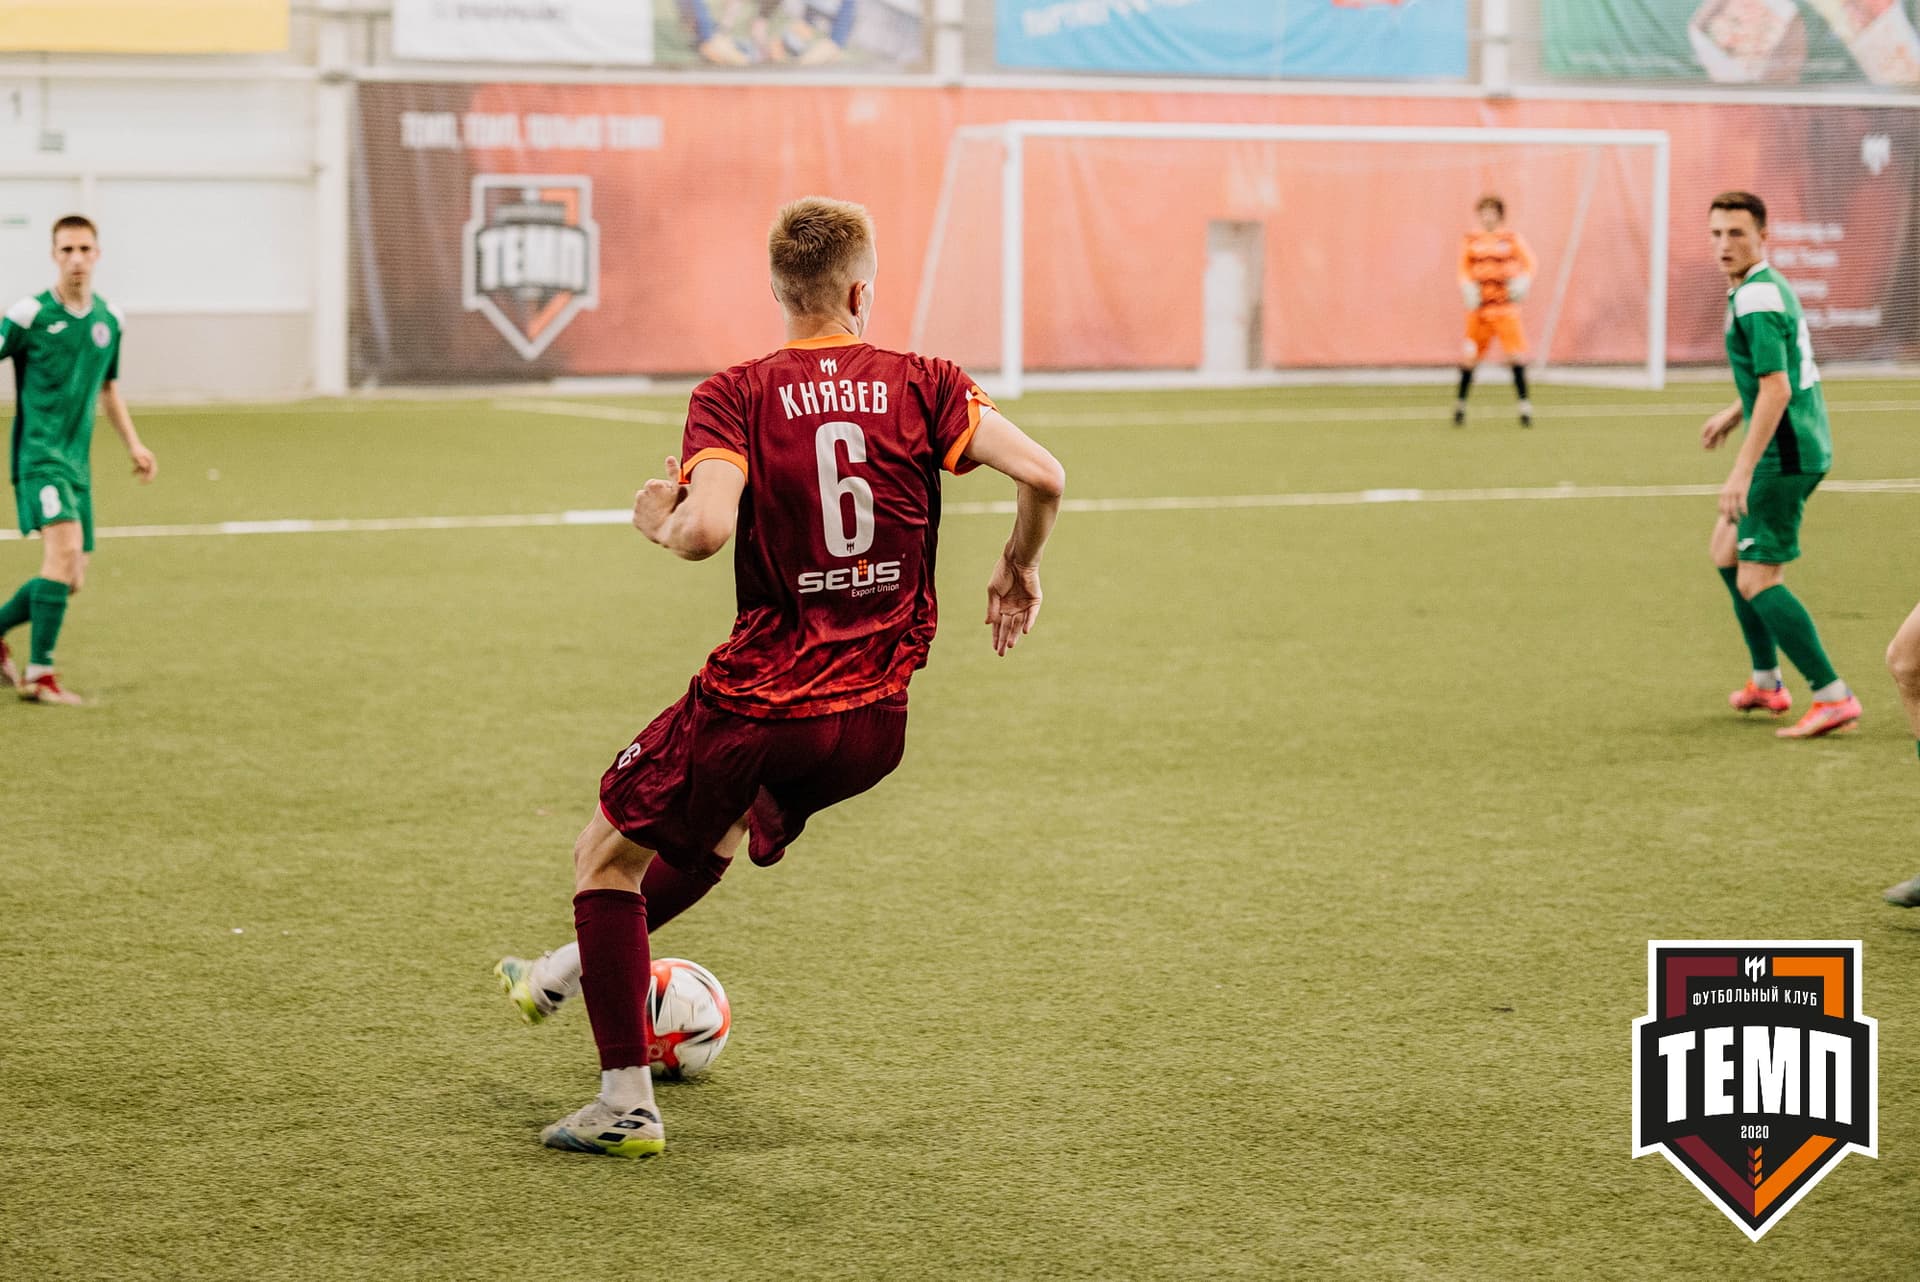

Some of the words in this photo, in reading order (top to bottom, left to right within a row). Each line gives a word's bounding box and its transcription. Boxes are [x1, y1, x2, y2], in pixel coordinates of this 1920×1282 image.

[778, 379, 888, 420] КНЯЗЕВ
[815, 421, 875, 558] 6
[851, 586, 876, 598] Export
[877, 583, 900, 593] Union
[617, 742, 641, 770] 6
